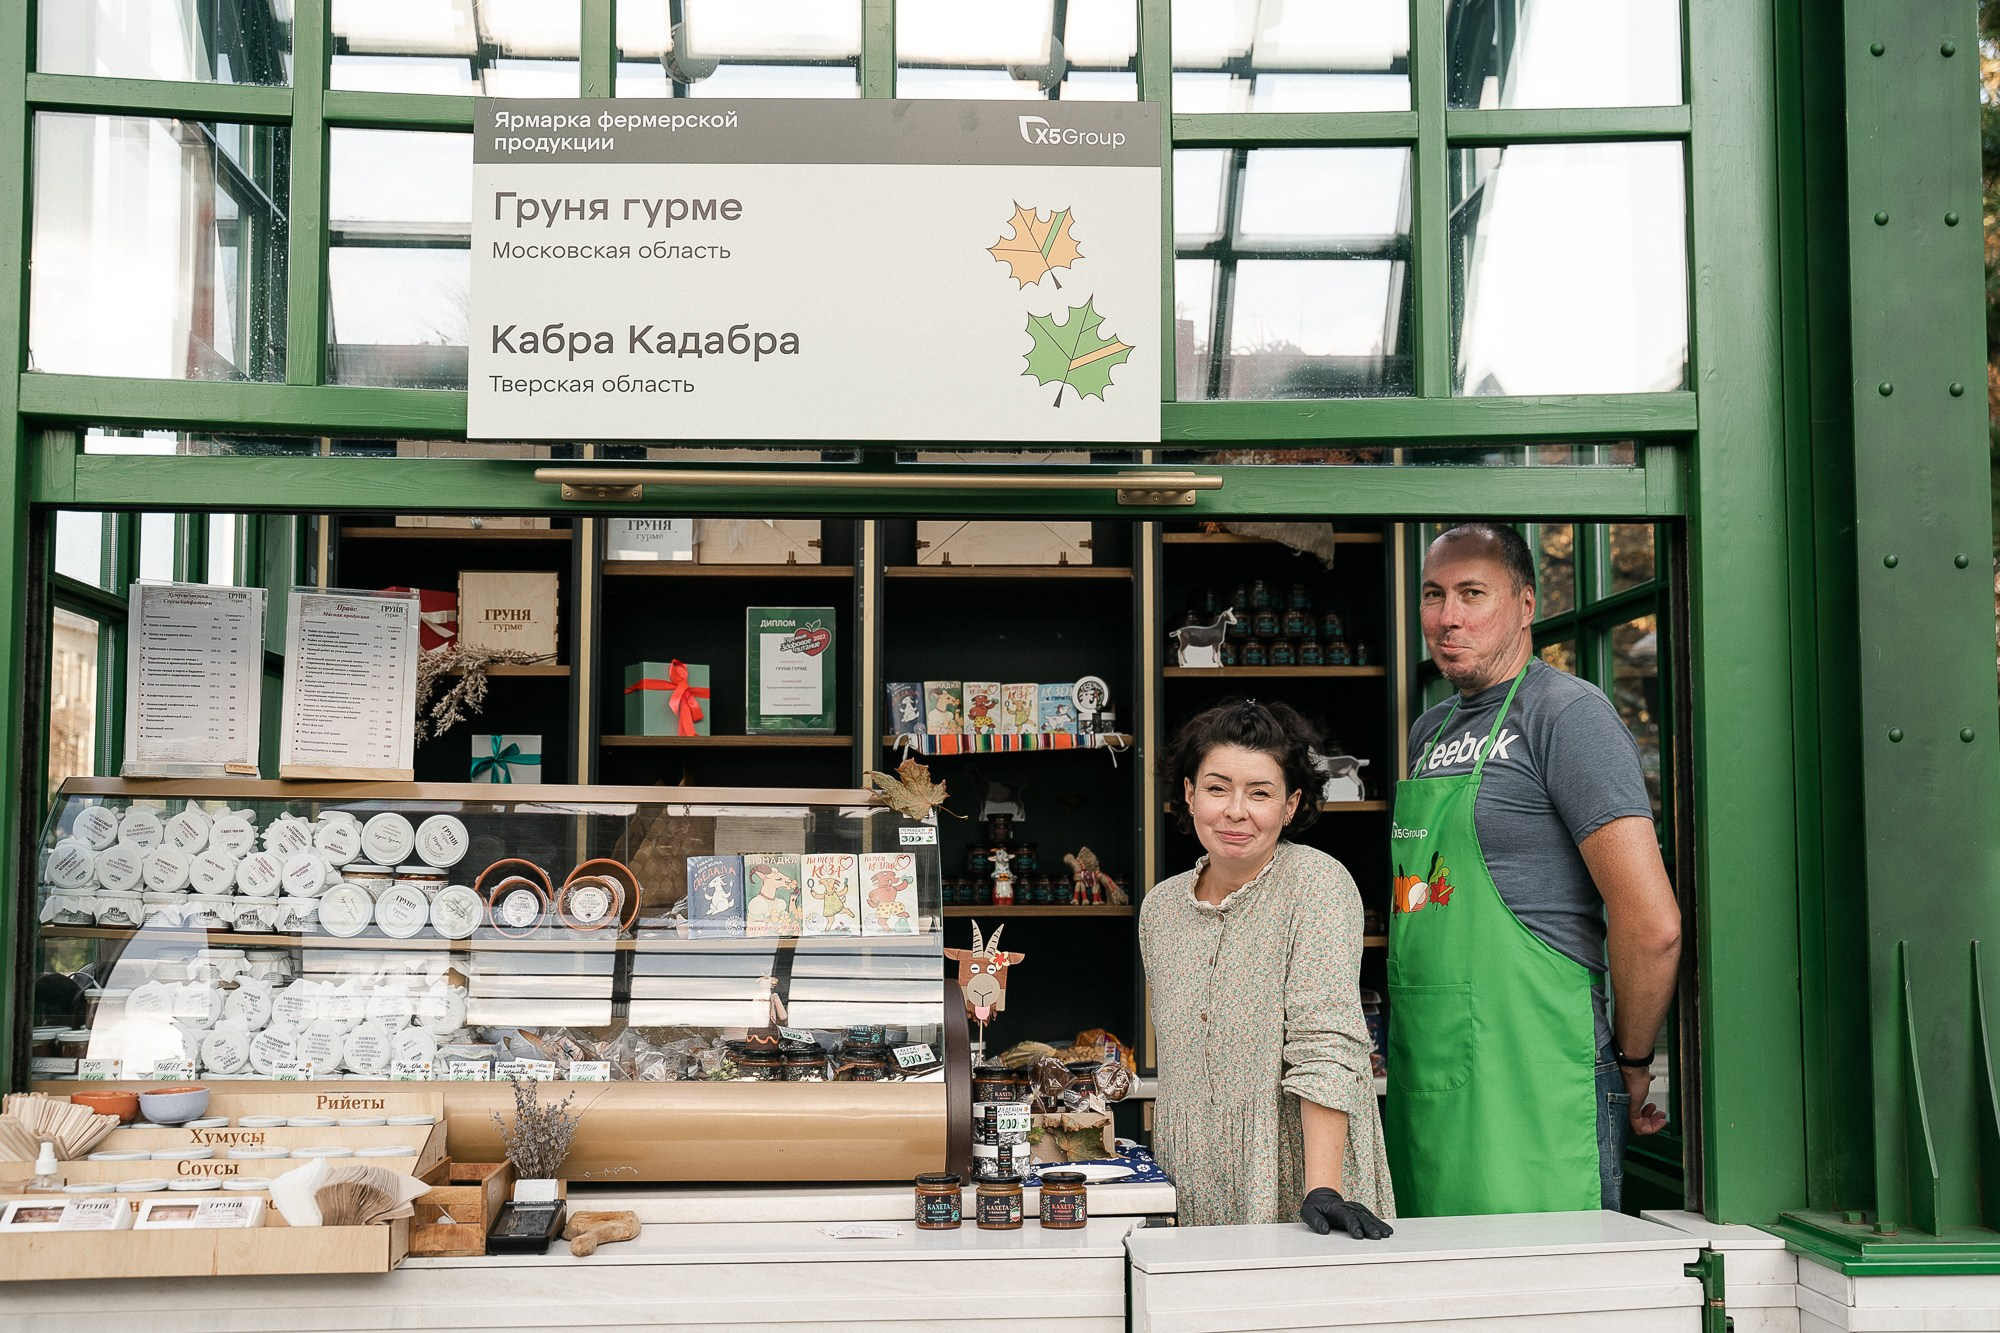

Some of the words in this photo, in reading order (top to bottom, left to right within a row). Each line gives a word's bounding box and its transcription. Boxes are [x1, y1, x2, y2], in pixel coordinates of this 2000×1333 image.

[494, 111, 591, 131] Ярмарка
[597, 110, 738, 132] фермерской
[494, 137, 614, 153] продукции
[1034, 126, 1126, 150] X5Group
[494, 191, 609, 229] Груня
[623, 198, 743, 229] гурме
[492, 241, 631, 259] Московская
[638, 240, 731, 259] область
[491, 322, 614, 362] Кабра
[628, 323, 800, 362] Кадабра
[488, 374, 594, 397] Тверская
[601, 373, 695, 393] область
[628, 520, 672, 531] ГРУНЯ
[636, 532, 664, 542] гурме
[336, 604, 358, 612] Прайс
[381, 605, 404, 614] ГРУНЯ
[484, 609, 531, 621] ГРУНЯ
[493, 623, 523, 632] гурме
[760, 619, 796, 629] ДИПЛОМ
[442, 824, 459, 846] ГРУНЯ
[749, 856, 798, 865] ПОМАДКА
[811, 863, 842, 879] КОЗА
[395, 895, 417, 910] ГРУНЯ
[900, 1054, 922, 1066] 300
[316, 1094, 386, 1112] Рийеты
[999, 1118, 1017, 1129] 200
[190, 1128, 266, 1148] Хумусы
[176, 1160, 240, 1179] Соусы
